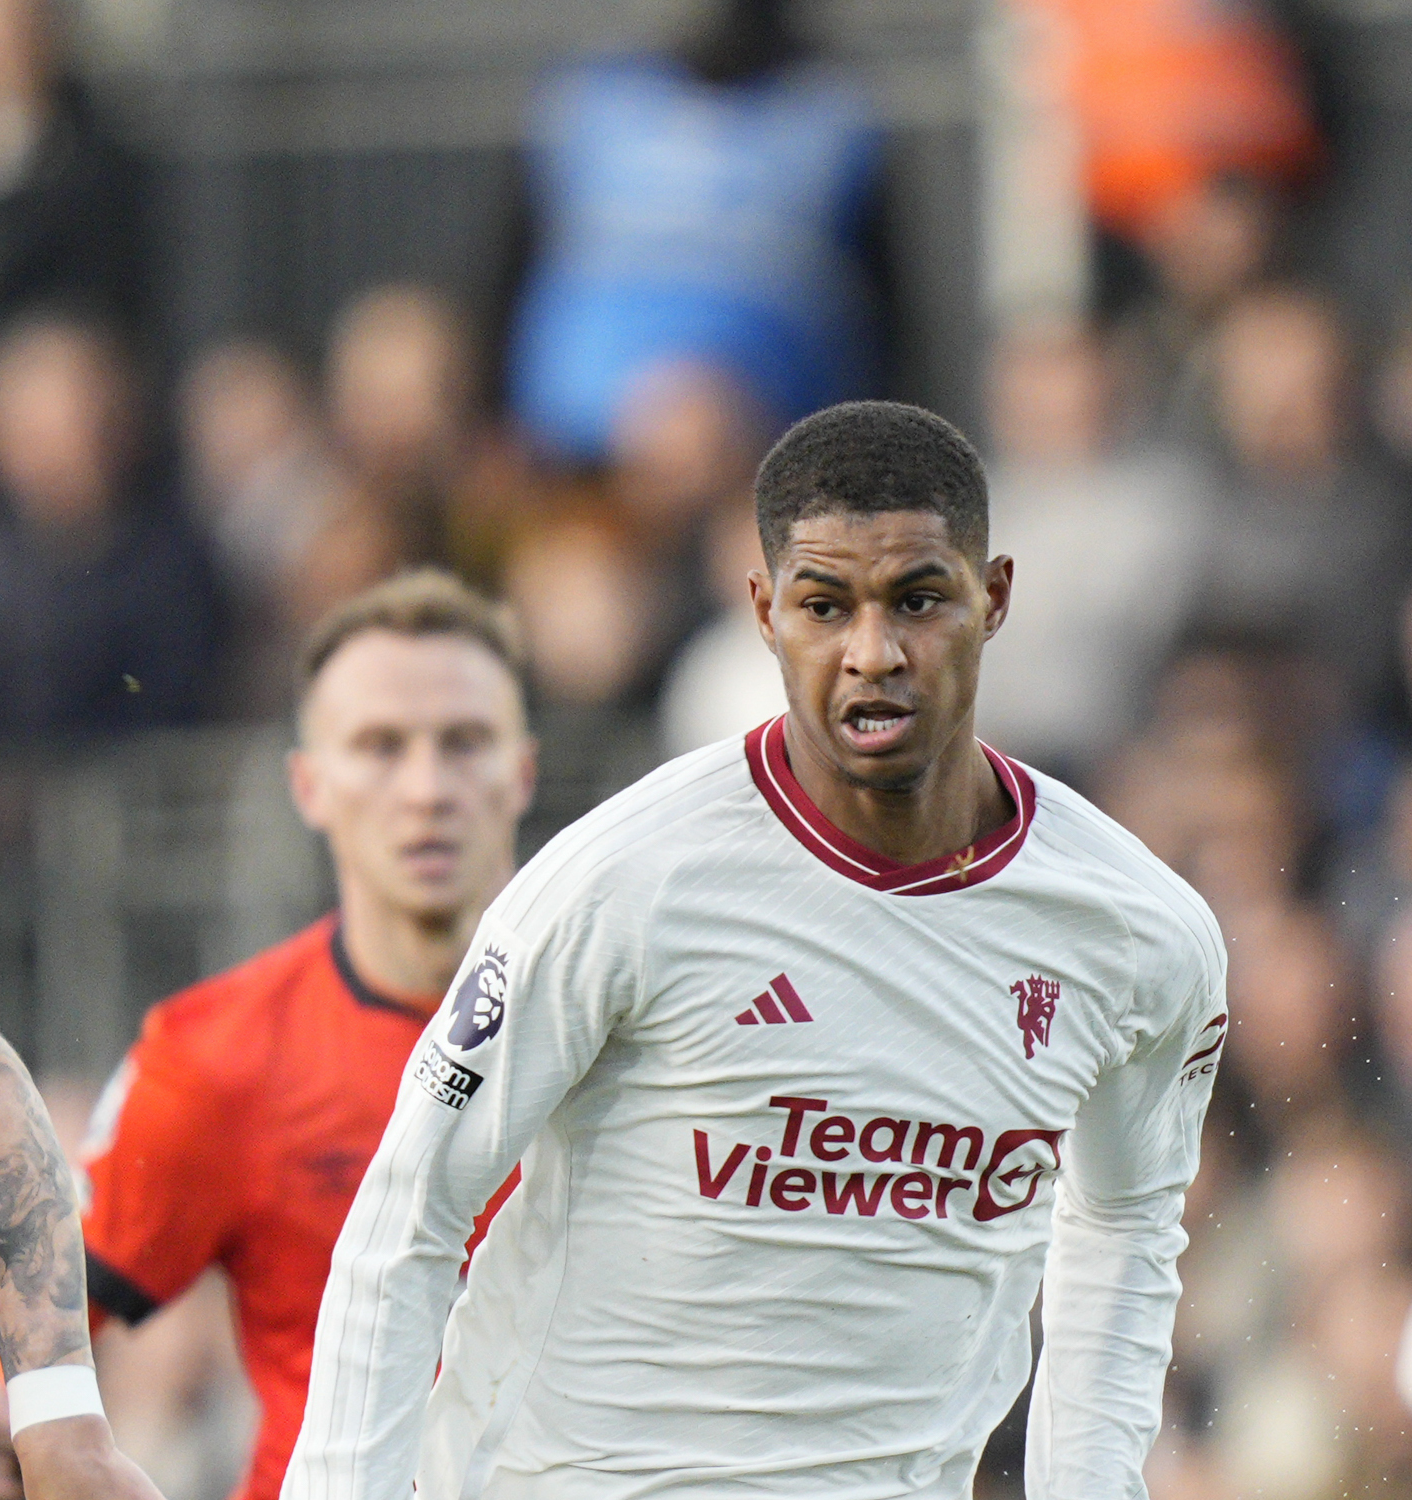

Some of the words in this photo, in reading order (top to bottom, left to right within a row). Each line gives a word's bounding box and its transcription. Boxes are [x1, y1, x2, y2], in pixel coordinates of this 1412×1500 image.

[1179, 1062, 1219, 1087] TEC
[769, 1096, 984, 1170] Team
[693, 1128, 973, 1219] Viewer
